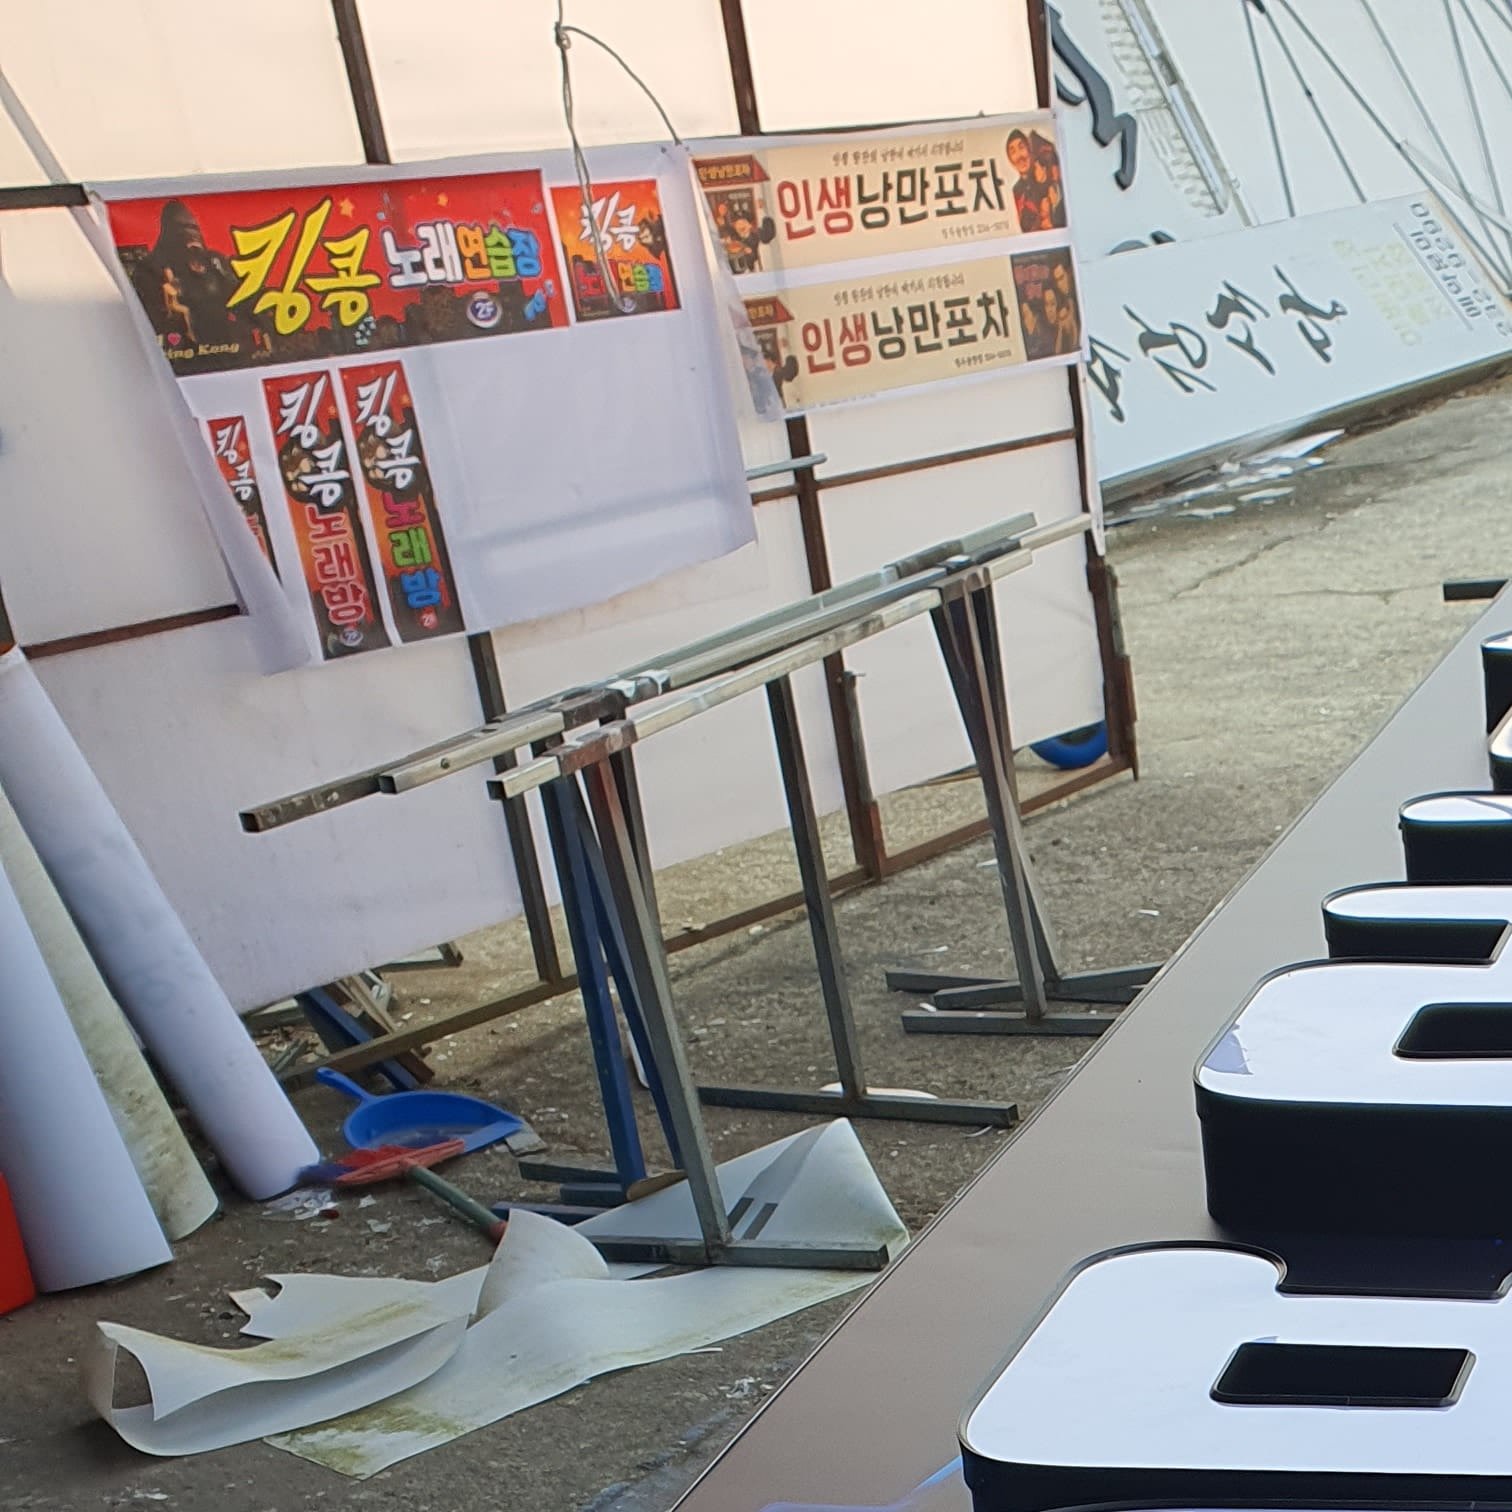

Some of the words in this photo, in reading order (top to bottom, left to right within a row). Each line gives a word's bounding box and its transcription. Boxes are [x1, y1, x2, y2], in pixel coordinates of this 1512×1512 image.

[777, 157, 1008, 241] 인생낭만포차
[226, 195, 382, 335] 킹콩
[382, 221, 543, 288] 노래연습장
[474, 300, 495, 318] 2F
[198, 343, 240, 355] Kong
[802, 288, 1012, 374] 인생낭만포차
[276, 371, 351, 508] 킹콩
[355, 369, 421, 490] 킹콩
[304, 504, 367, 626] 노래방
[384, 492, 443, 609] 노래방
